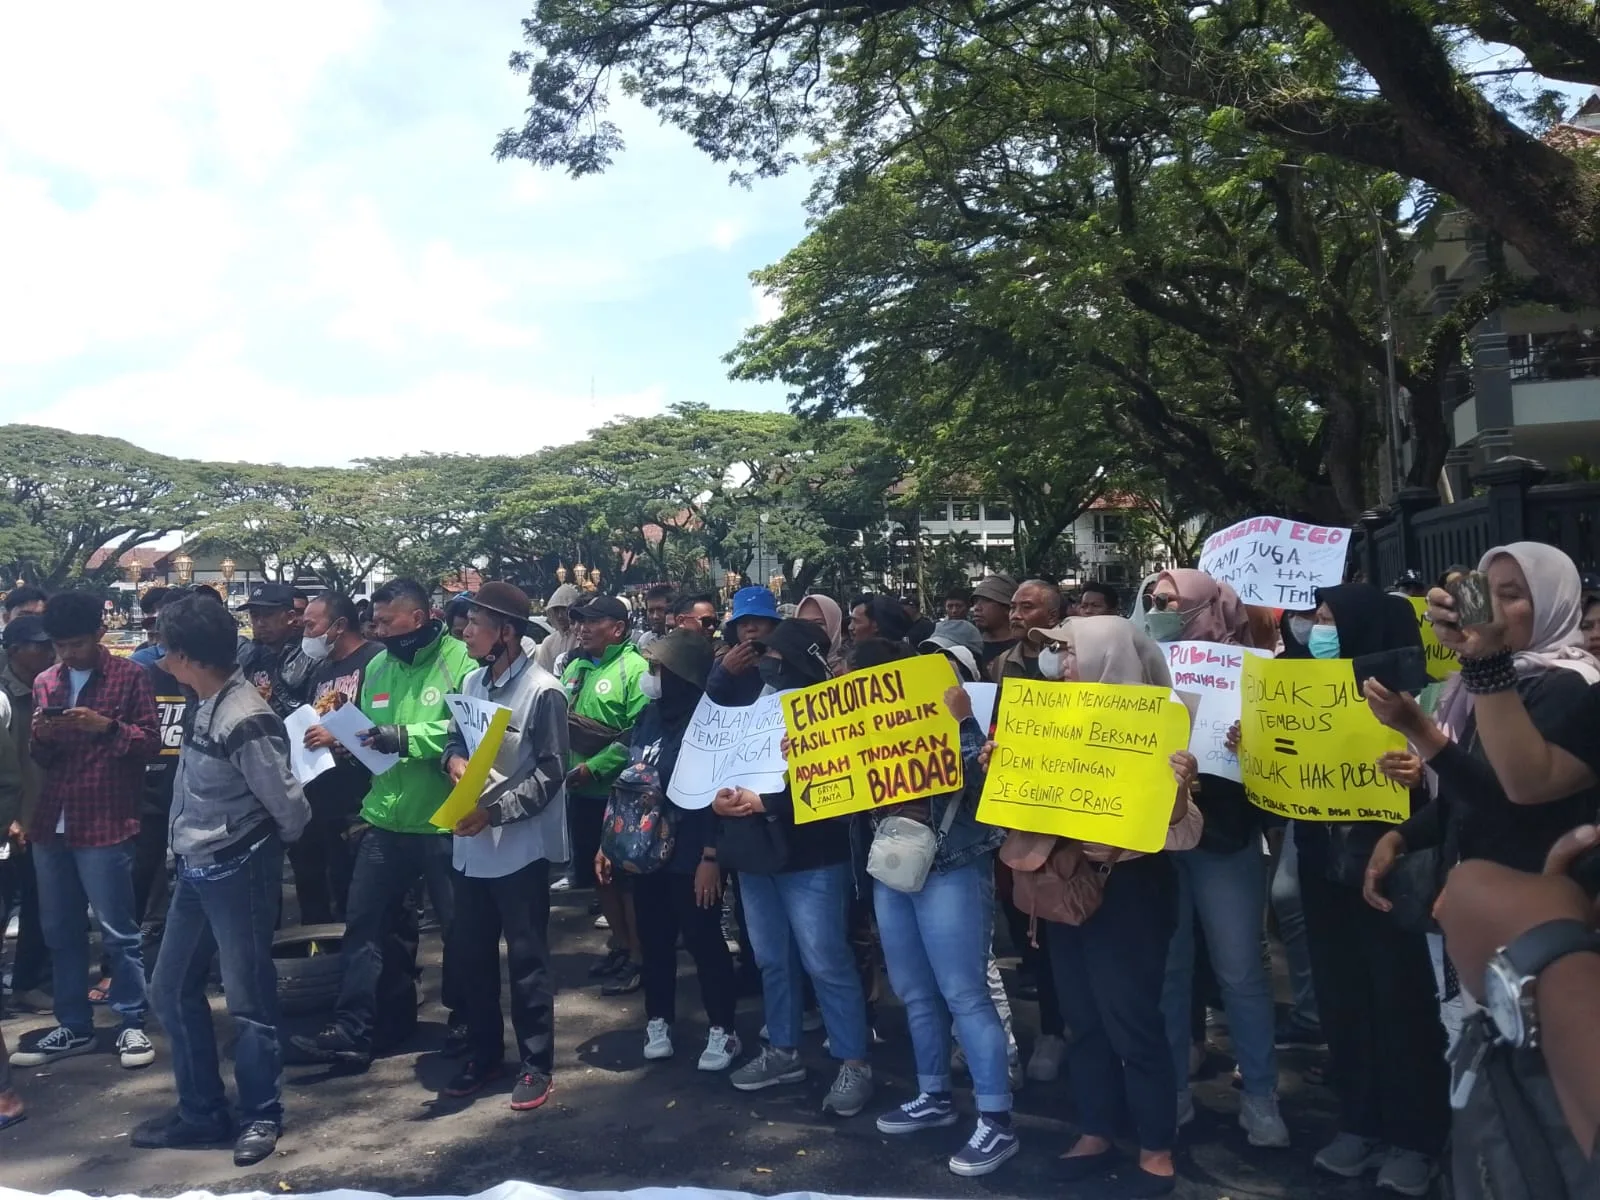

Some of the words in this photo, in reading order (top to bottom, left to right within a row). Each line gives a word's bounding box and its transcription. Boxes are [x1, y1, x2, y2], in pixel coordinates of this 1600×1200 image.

[1289, 522, 1343, 544] EGO
[1244, 541, 1303, 565] JUGA
[1277, 568, 1323, 583] HAK
[1169, 644, 1242, 669] PUBLIK
[790, 669, 906, 732] EKSPLOITASI
[1008, 684, 1073, 709] JANGAN
[1076, 690, 1166, 714] MENGHAMBAT
[790, 721, 866, 759] FASILITAS
[873, 702, 940, 731] PUBLIK
[1004, 711, 1083, 741] KEPENTINGAN
[1089, 721, 1158, 748] BERSAMA
[1256, 709, 1333, 732] TEMBUS
[795, 755, 851, 784] ADALAH
[857, 733, 948, 767] TINDAKAN
[1000, 747, 1034, 769] DEMI
[1041, 753, 1116, 779] KEPENTINGAN
[866, 748, 958, 805] BIADAB
[1299, 763, 1335, 790] HAK
[1069, 788, 1123, 811] ORANG
